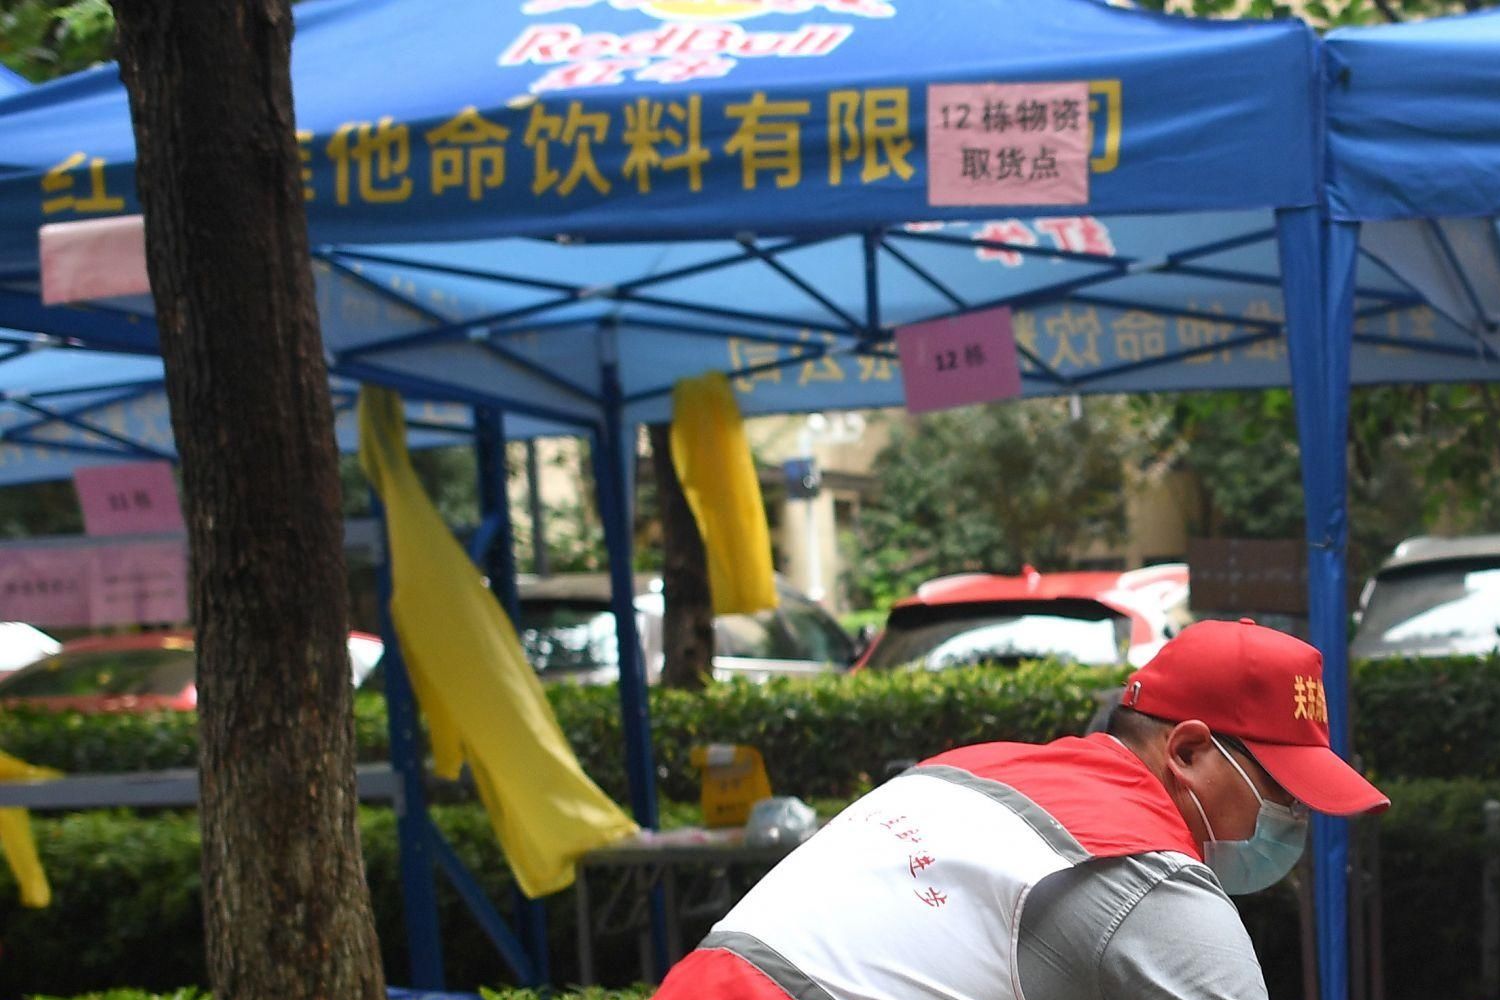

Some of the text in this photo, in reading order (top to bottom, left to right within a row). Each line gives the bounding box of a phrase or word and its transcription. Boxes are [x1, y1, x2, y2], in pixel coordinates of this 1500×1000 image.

[941, 98, 1081, 133] 12 栋物资
[961, 145, 1062, 181] 取货点
[935, 350, 959, 372] 12
